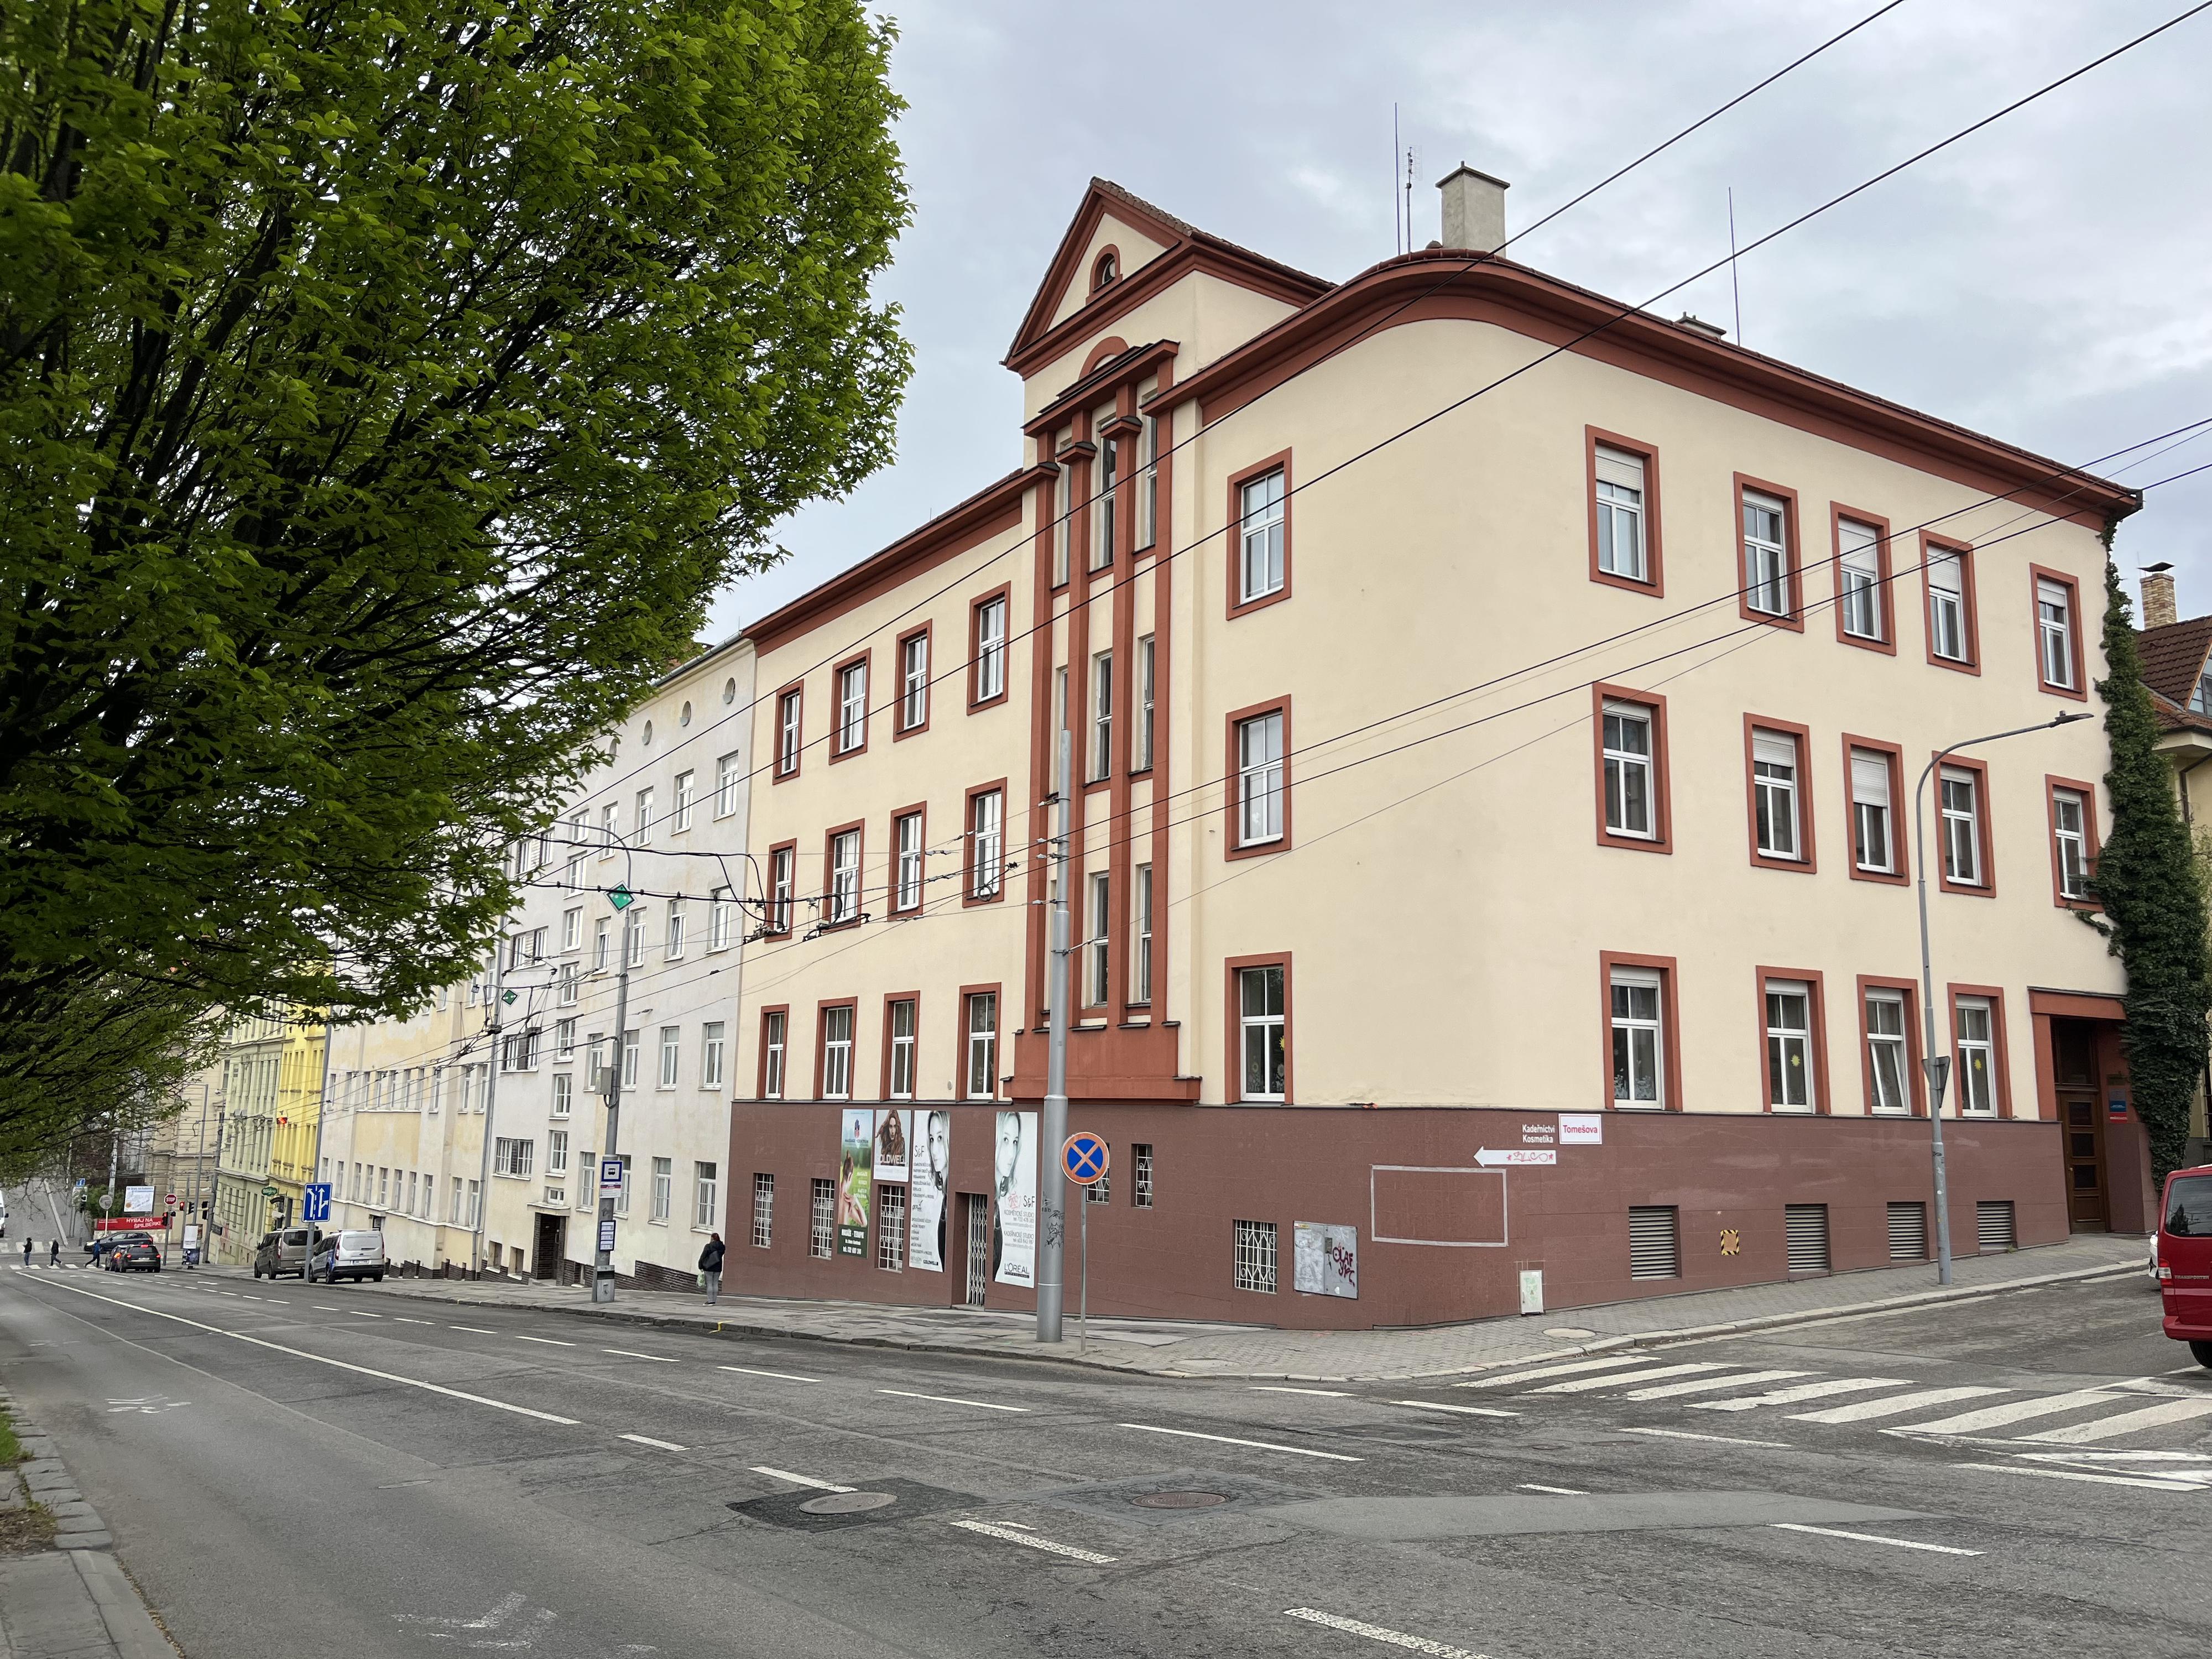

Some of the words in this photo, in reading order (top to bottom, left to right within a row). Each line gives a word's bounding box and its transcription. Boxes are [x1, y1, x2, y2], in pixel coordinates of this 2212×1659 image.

[1563, 1125, 1598, 1134] Tomešova
[1522, 1134, 1553, 1143] Kosmetika
[1023, 1195, 1035, 1208] S&F
